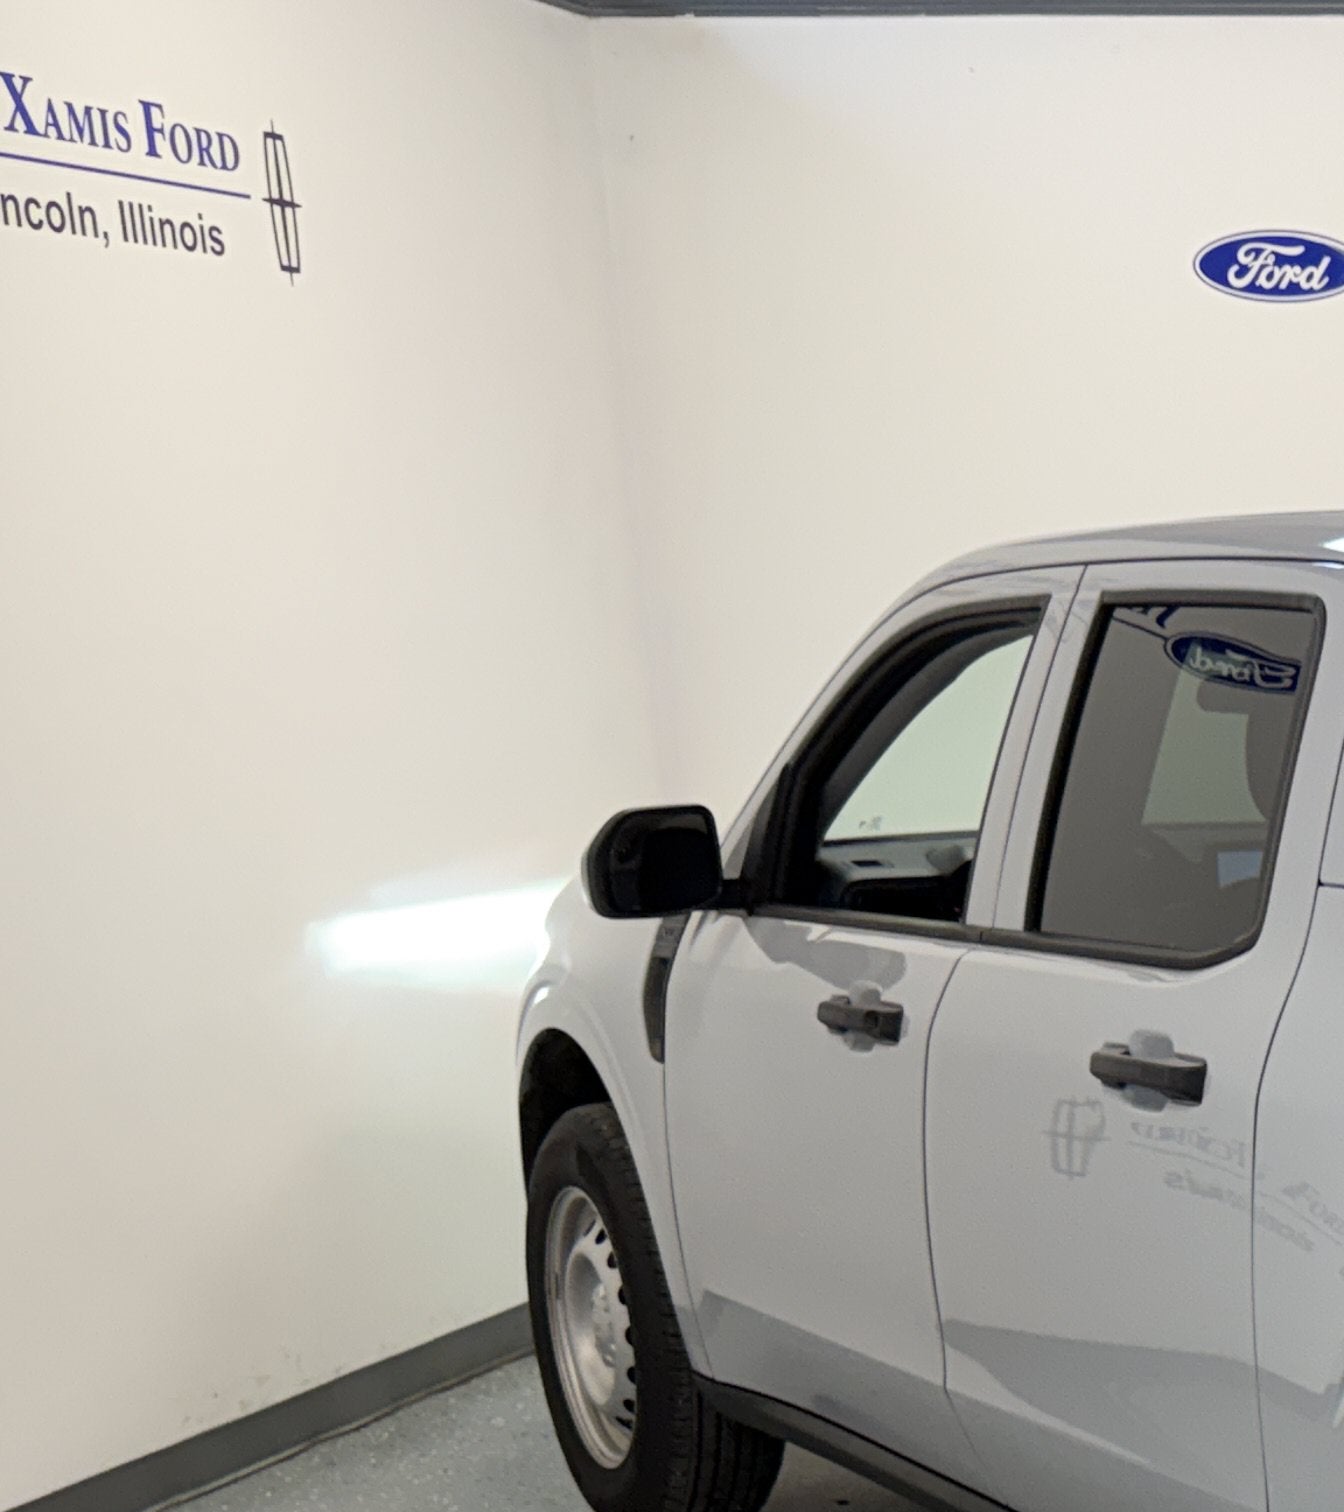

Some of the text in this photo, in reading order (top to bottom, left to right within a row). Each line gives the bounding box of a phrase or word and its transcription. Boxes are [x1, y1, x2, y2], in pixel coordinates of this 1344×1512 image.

[0, 71, 240, 172] XAMIS FORD
[118, 199, 226, 257] Illinois
[1226, 241, 1331, 290] Ford
